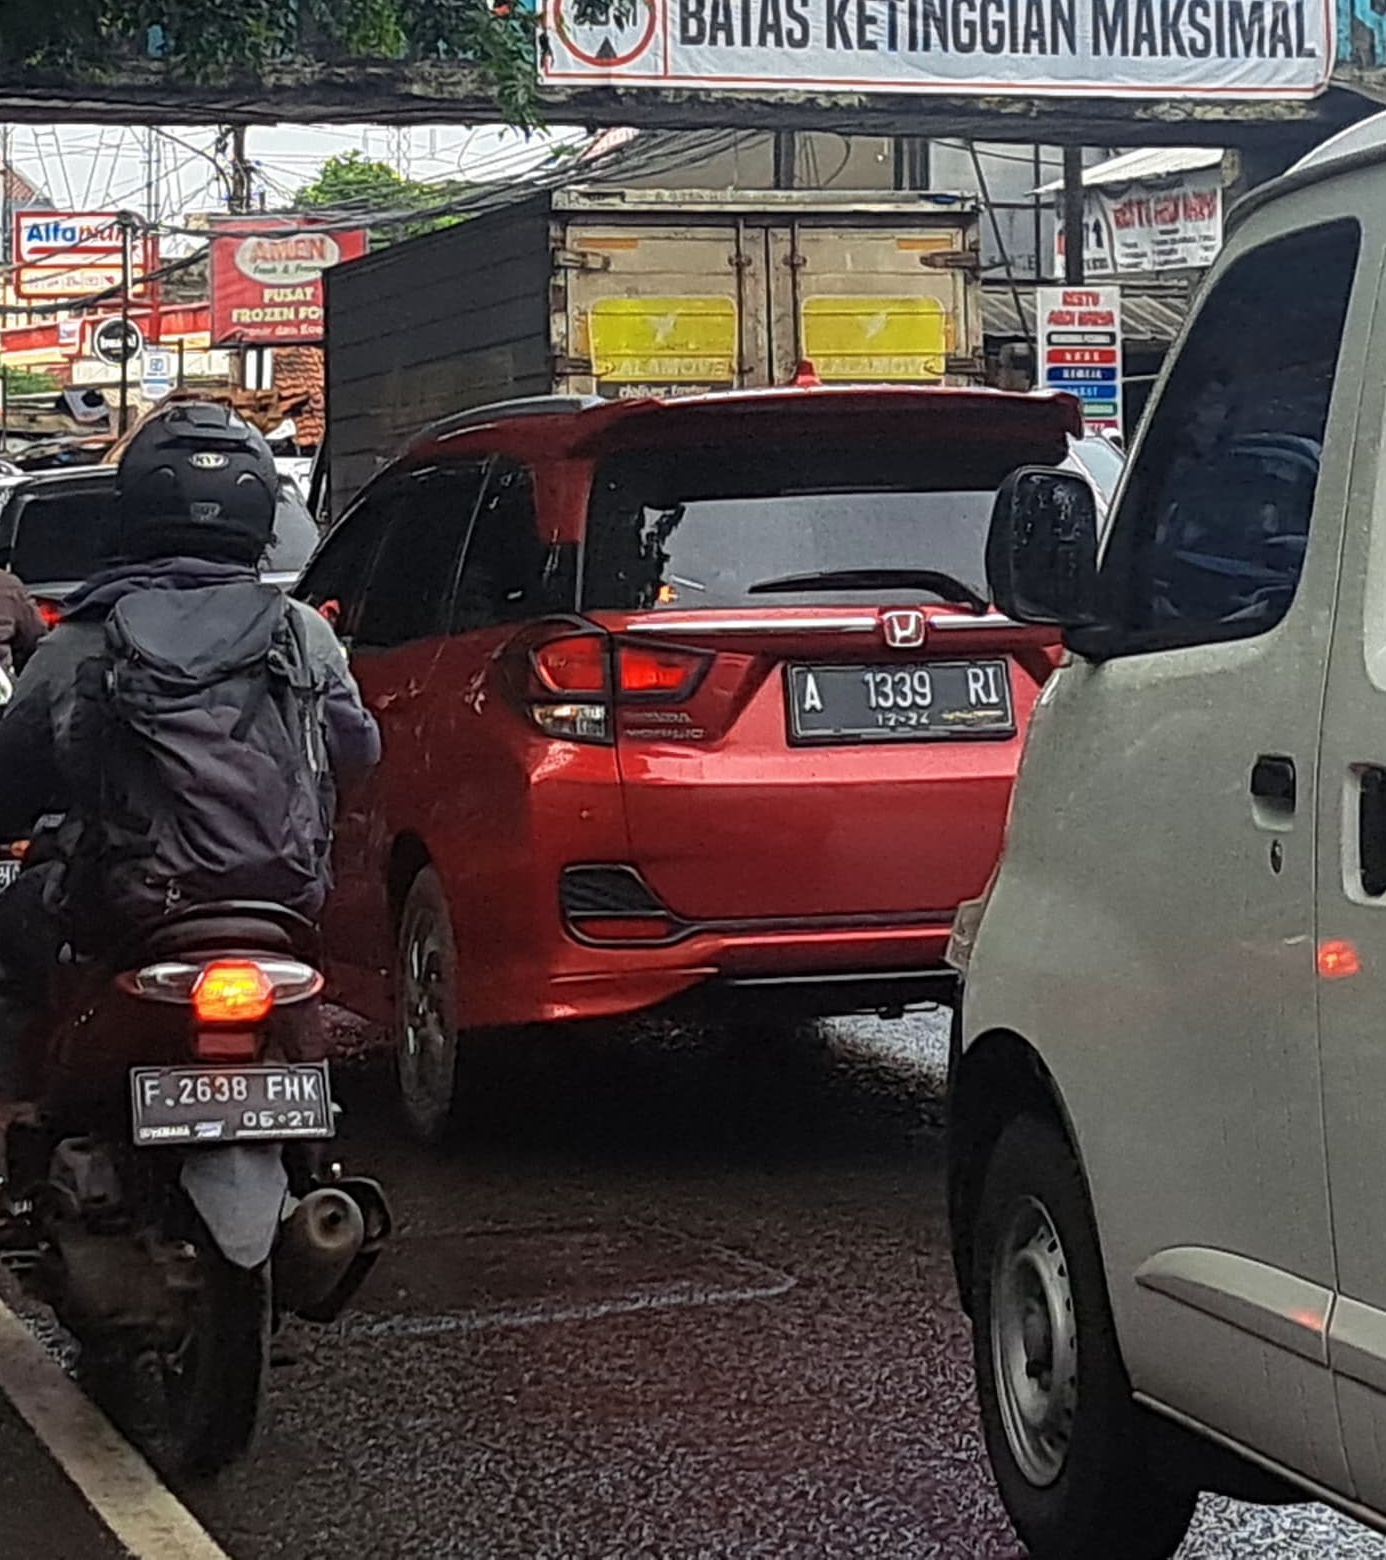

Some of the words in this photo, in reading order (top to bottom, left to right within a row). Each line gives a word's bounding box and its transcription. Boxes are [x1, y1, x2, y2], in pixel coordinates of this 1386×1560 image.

[26, 222, 139, 243] Alfamar
[231, 306, 295, 323] FROZEN
[298, 306, 324, 322] FO
[803, 673, 823, 712] A
[863, 671, 932, 710] 1339
[967, 667, 1001, 706] RI
[266, 1074, 319, 1103] FHK
